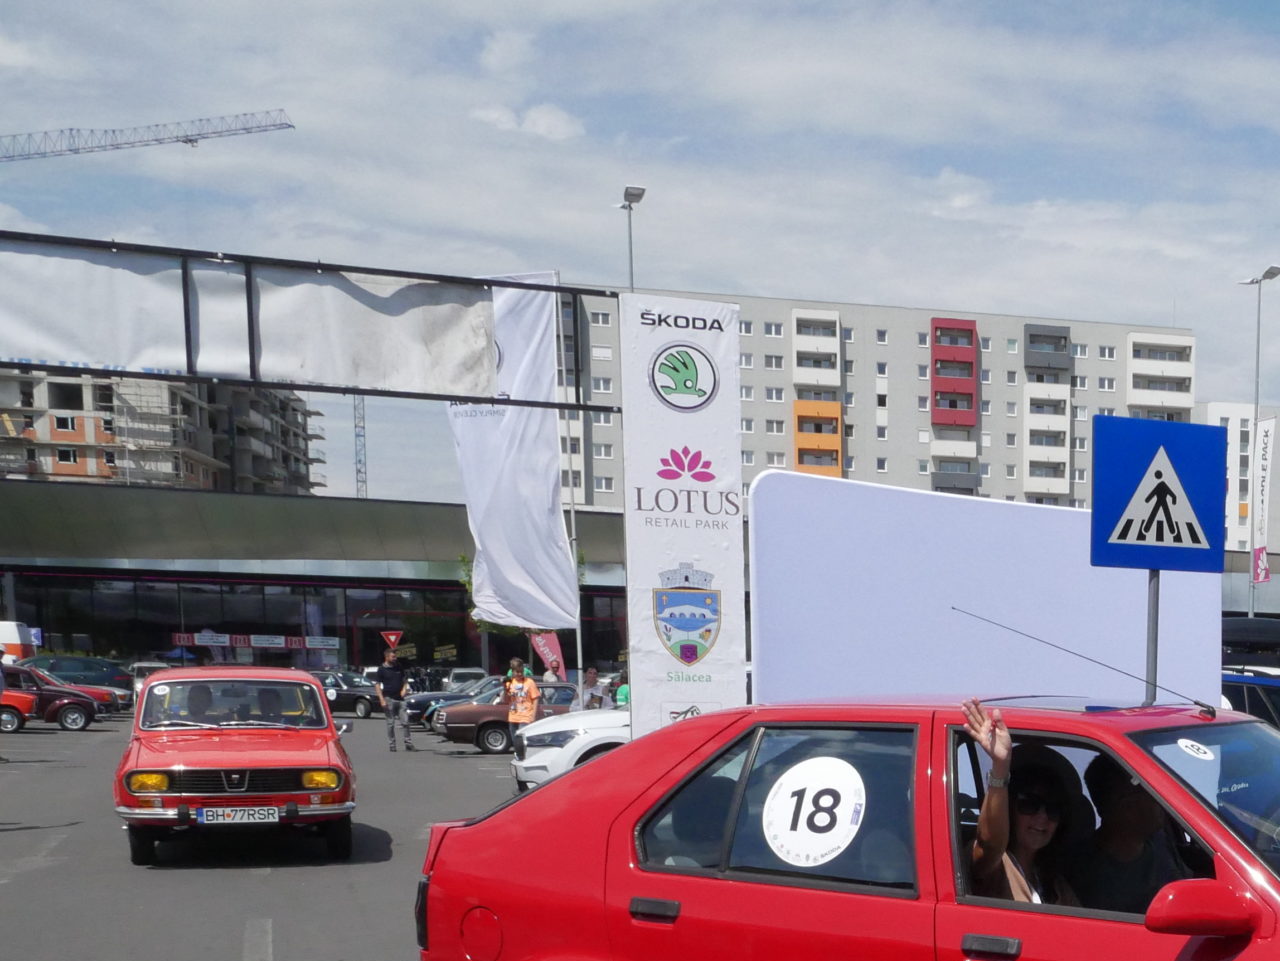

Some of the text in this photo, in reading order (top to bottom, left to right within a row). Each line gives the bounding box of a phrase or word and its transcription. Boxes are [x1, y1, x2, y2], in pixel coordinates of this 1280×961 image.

[640, 309, 724, 332] ŠKODA
[1261, 429, 1270, 461] PACK
[634, 487, 740, 516] LOTUS
[645, 517, 729, 530] RETAIL PARK
[666, 671, 712, 682] Sălacea
[788, 787, 842, 834] 18
